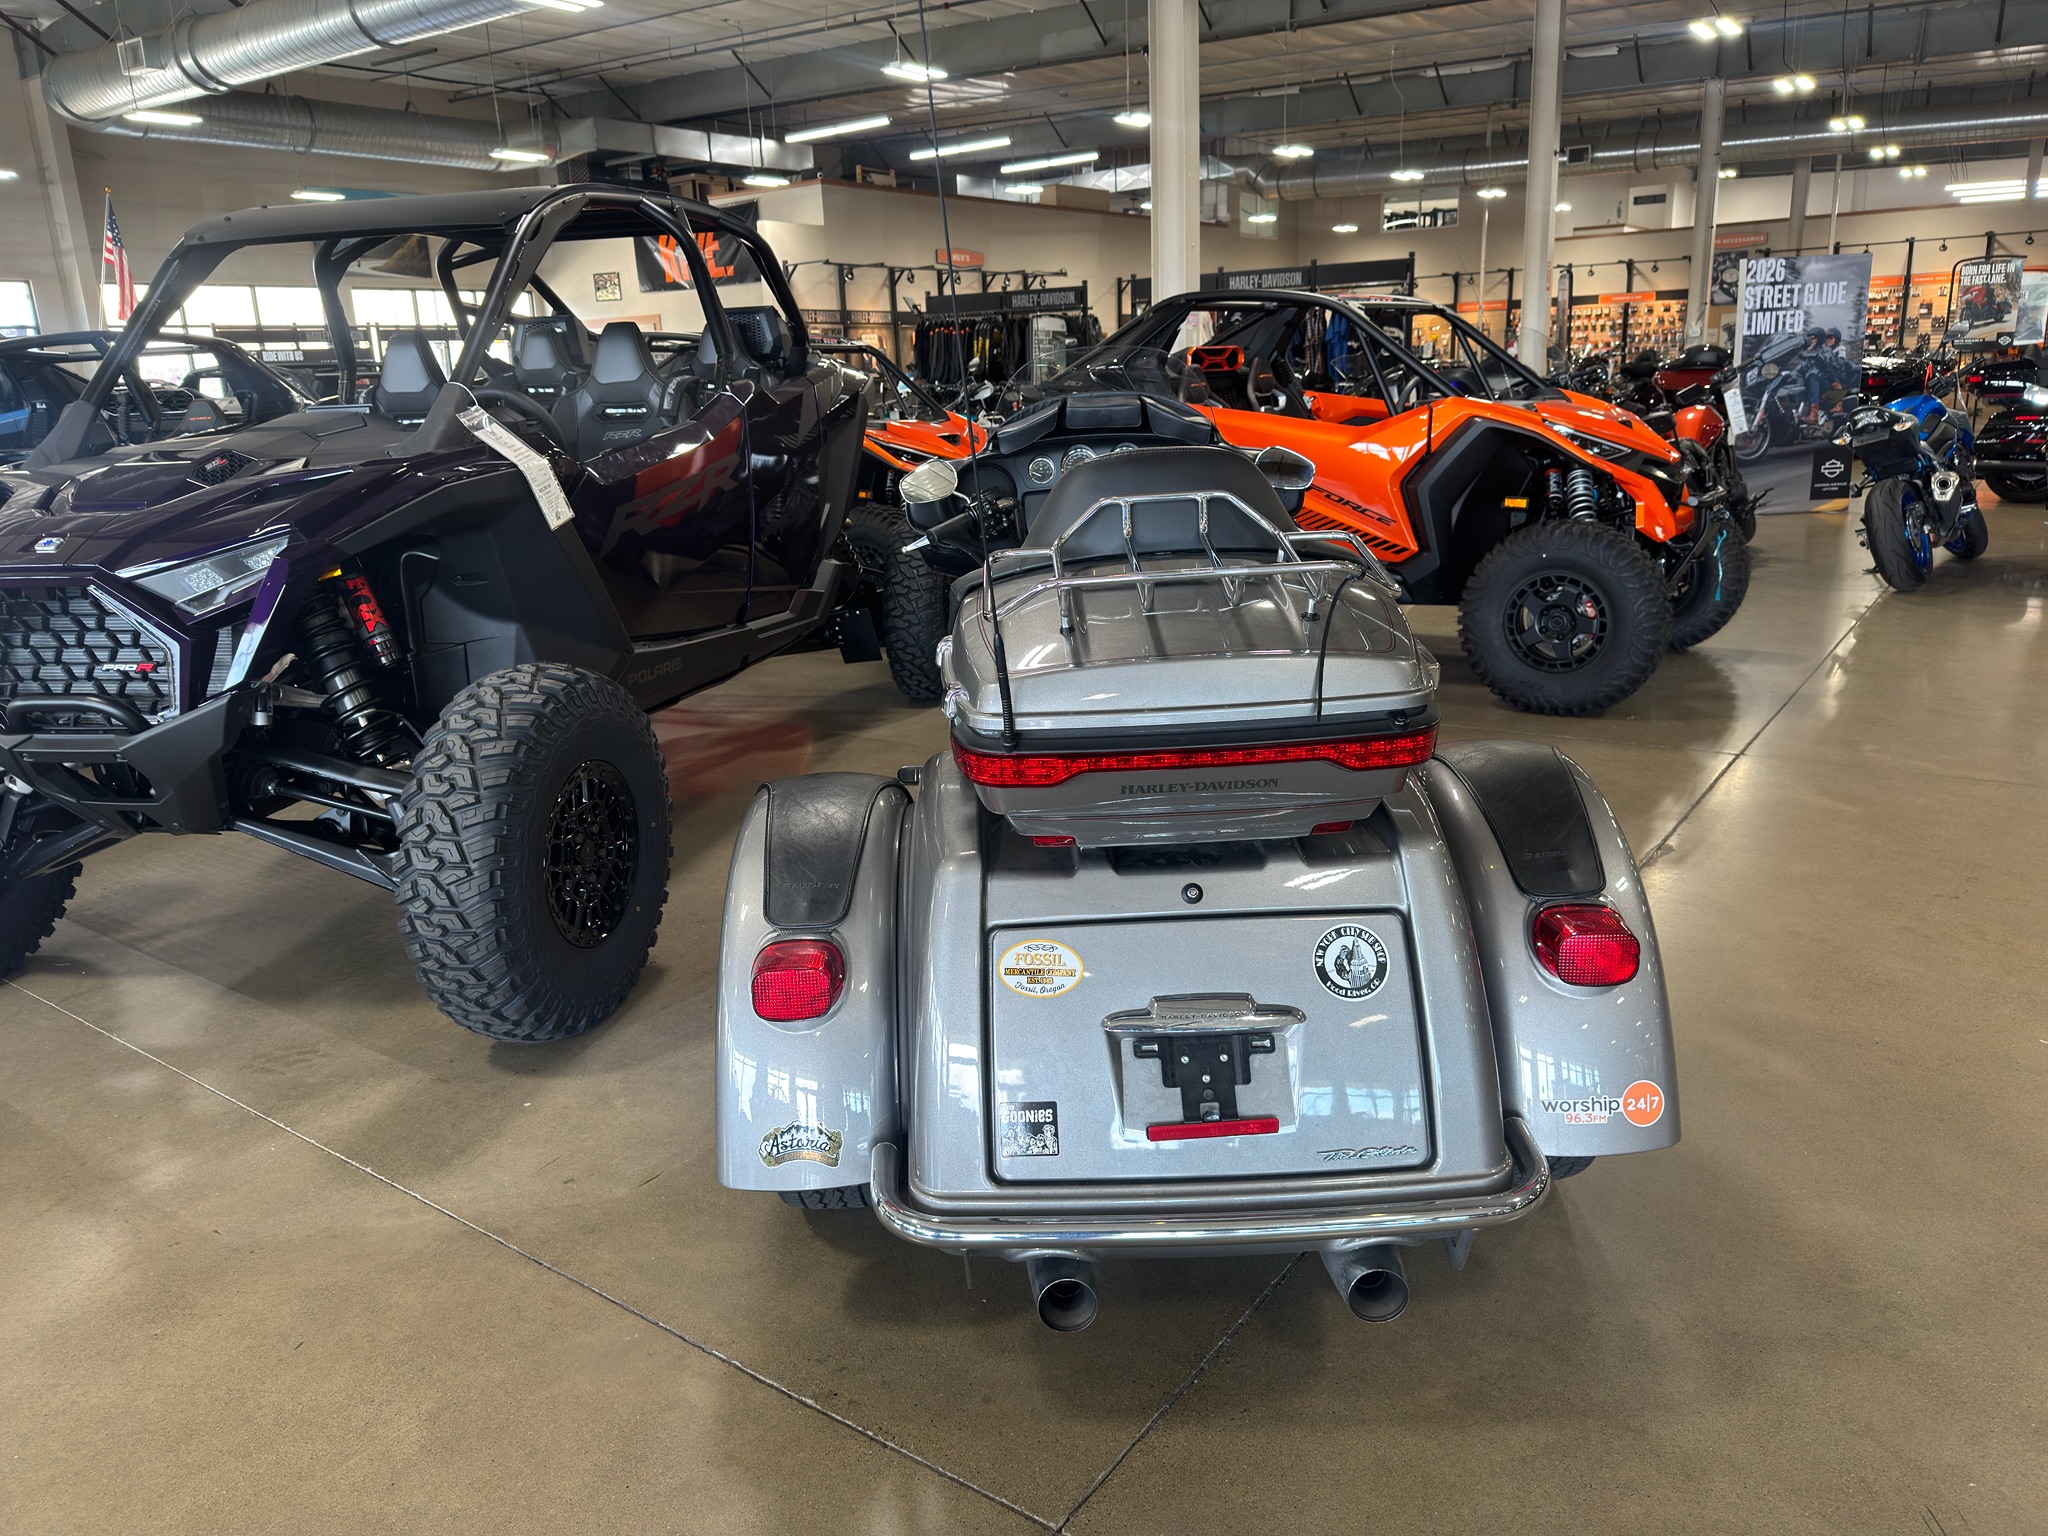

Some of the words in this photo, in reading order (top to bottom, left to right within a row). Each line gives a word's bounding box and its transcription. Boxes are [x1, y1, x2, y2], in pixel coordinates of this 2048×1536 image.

[952, 253, 970, 262] MEN'S
[1745, 258, 1786, 283] 2026
[1961, 265, 1979, 276] BORN
[1978, 264, 1991, 274] FOR
[1992, 263, 2007, 273] LIFE
[2007, 262, 2016, 273] IN
[1229, 272, 1302, 289] HARLEY-DAVIDSON
[1960, 276, 1972, 286] THE
[1971, 275, 1987, 285] FAST
[1012, 291, 1075, 308] HARLEY-DAVIDSON
[1744, 284, 1801, 310] STREET
[1803, 281, 1848, 306] GLIDE
[1743, 310, 1805, 336] LIMITED
[262, 351, 278, 362] RIDE
[278, 351, 295, 361] WITH
[294, 350, 304, 361] US
[603, 429, 642, 440] RZR
[600, 453, 741, 556] RZR
[345, 576, 388, 632] FOX
[628, 657, 682, 688] POLARIS
[1121, 778, 1279, 795] HARLEY-DAVIDSON
[1316, 948, 1324, 966] NEW
[1320, 930, 1339, 947] YORK
[1341, 927, 1361, 936] CITY
[1361, 931, 1376, 944] SUB
[1373, 942, 1386, 963] SHOP
[1015, 952, 1066, 966] FOSSIL
[1004, 967, 1045, 976] MERCANTILE
[1046, 968, 1077, 977] COMPANY
[1015, 981, 1038, 994] Fossil,
[1040, 983, 1066, 994] Oregon
[1326, 980, 1346, 996] Hood
[1370, 978, 1381, 989] OR
[1161, 1010, 1248, 1020] HARLEY-DAVIDSON
[1541, 1097, 1620, 1115] worship
[760, 1133, 831, 1157] Astoria
